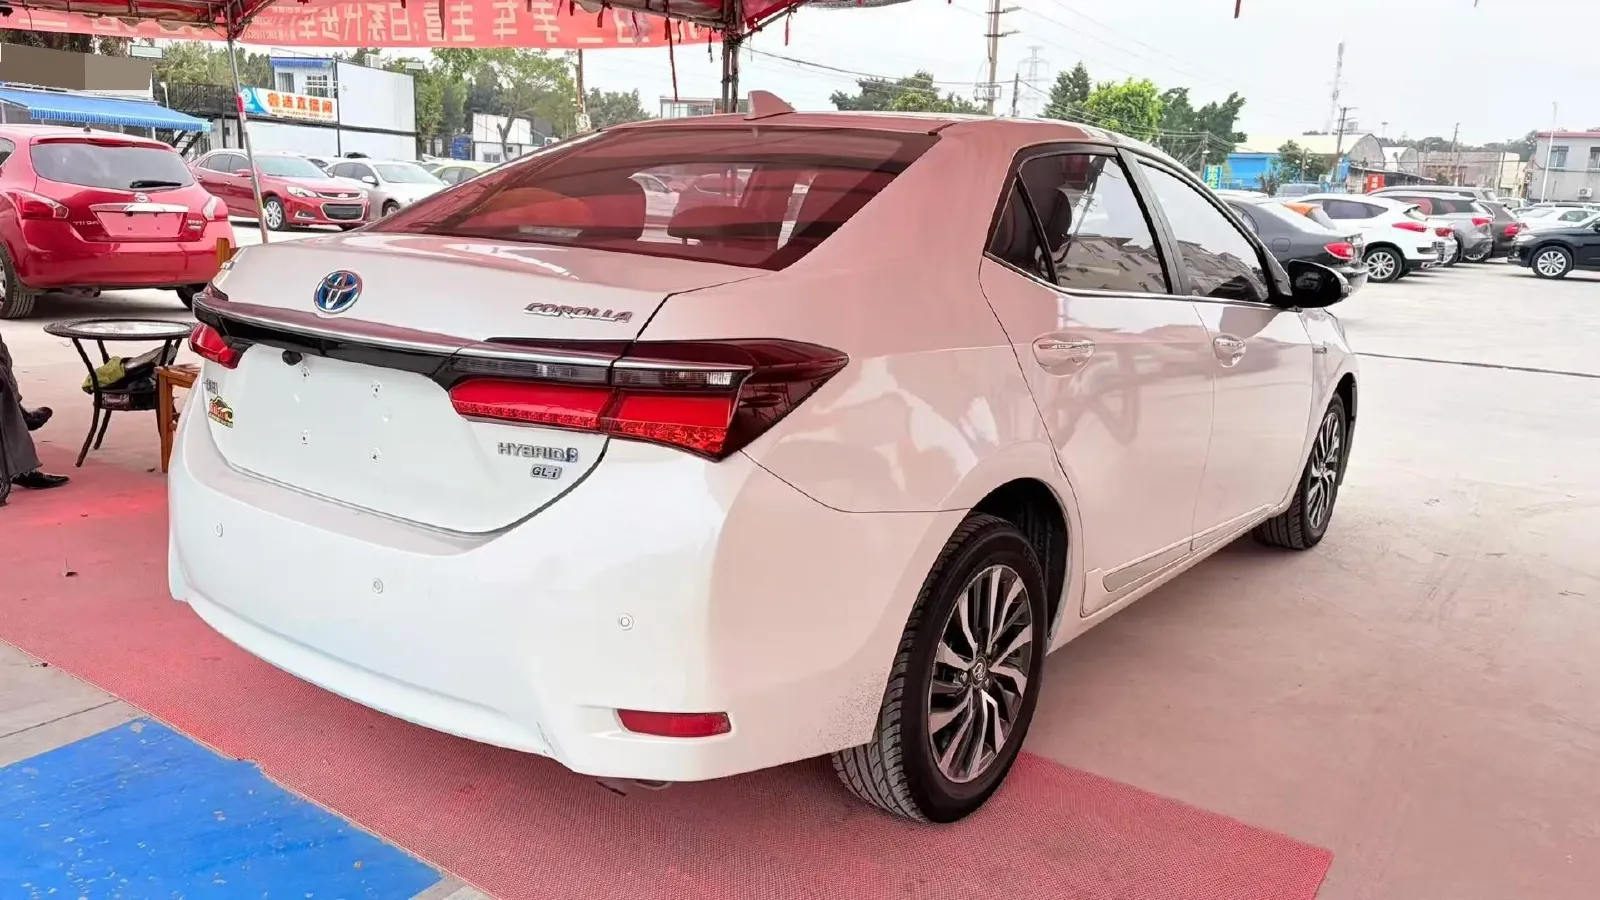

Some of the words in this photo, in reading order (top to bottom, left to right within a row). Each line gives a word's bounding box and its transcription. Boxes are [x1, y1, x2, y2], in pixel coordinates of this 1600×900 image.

[523, 302, 633, 323] COROLLA
[497, 442, 565, 462] HYBRID
[532, 466, 558, 478] GL-i
